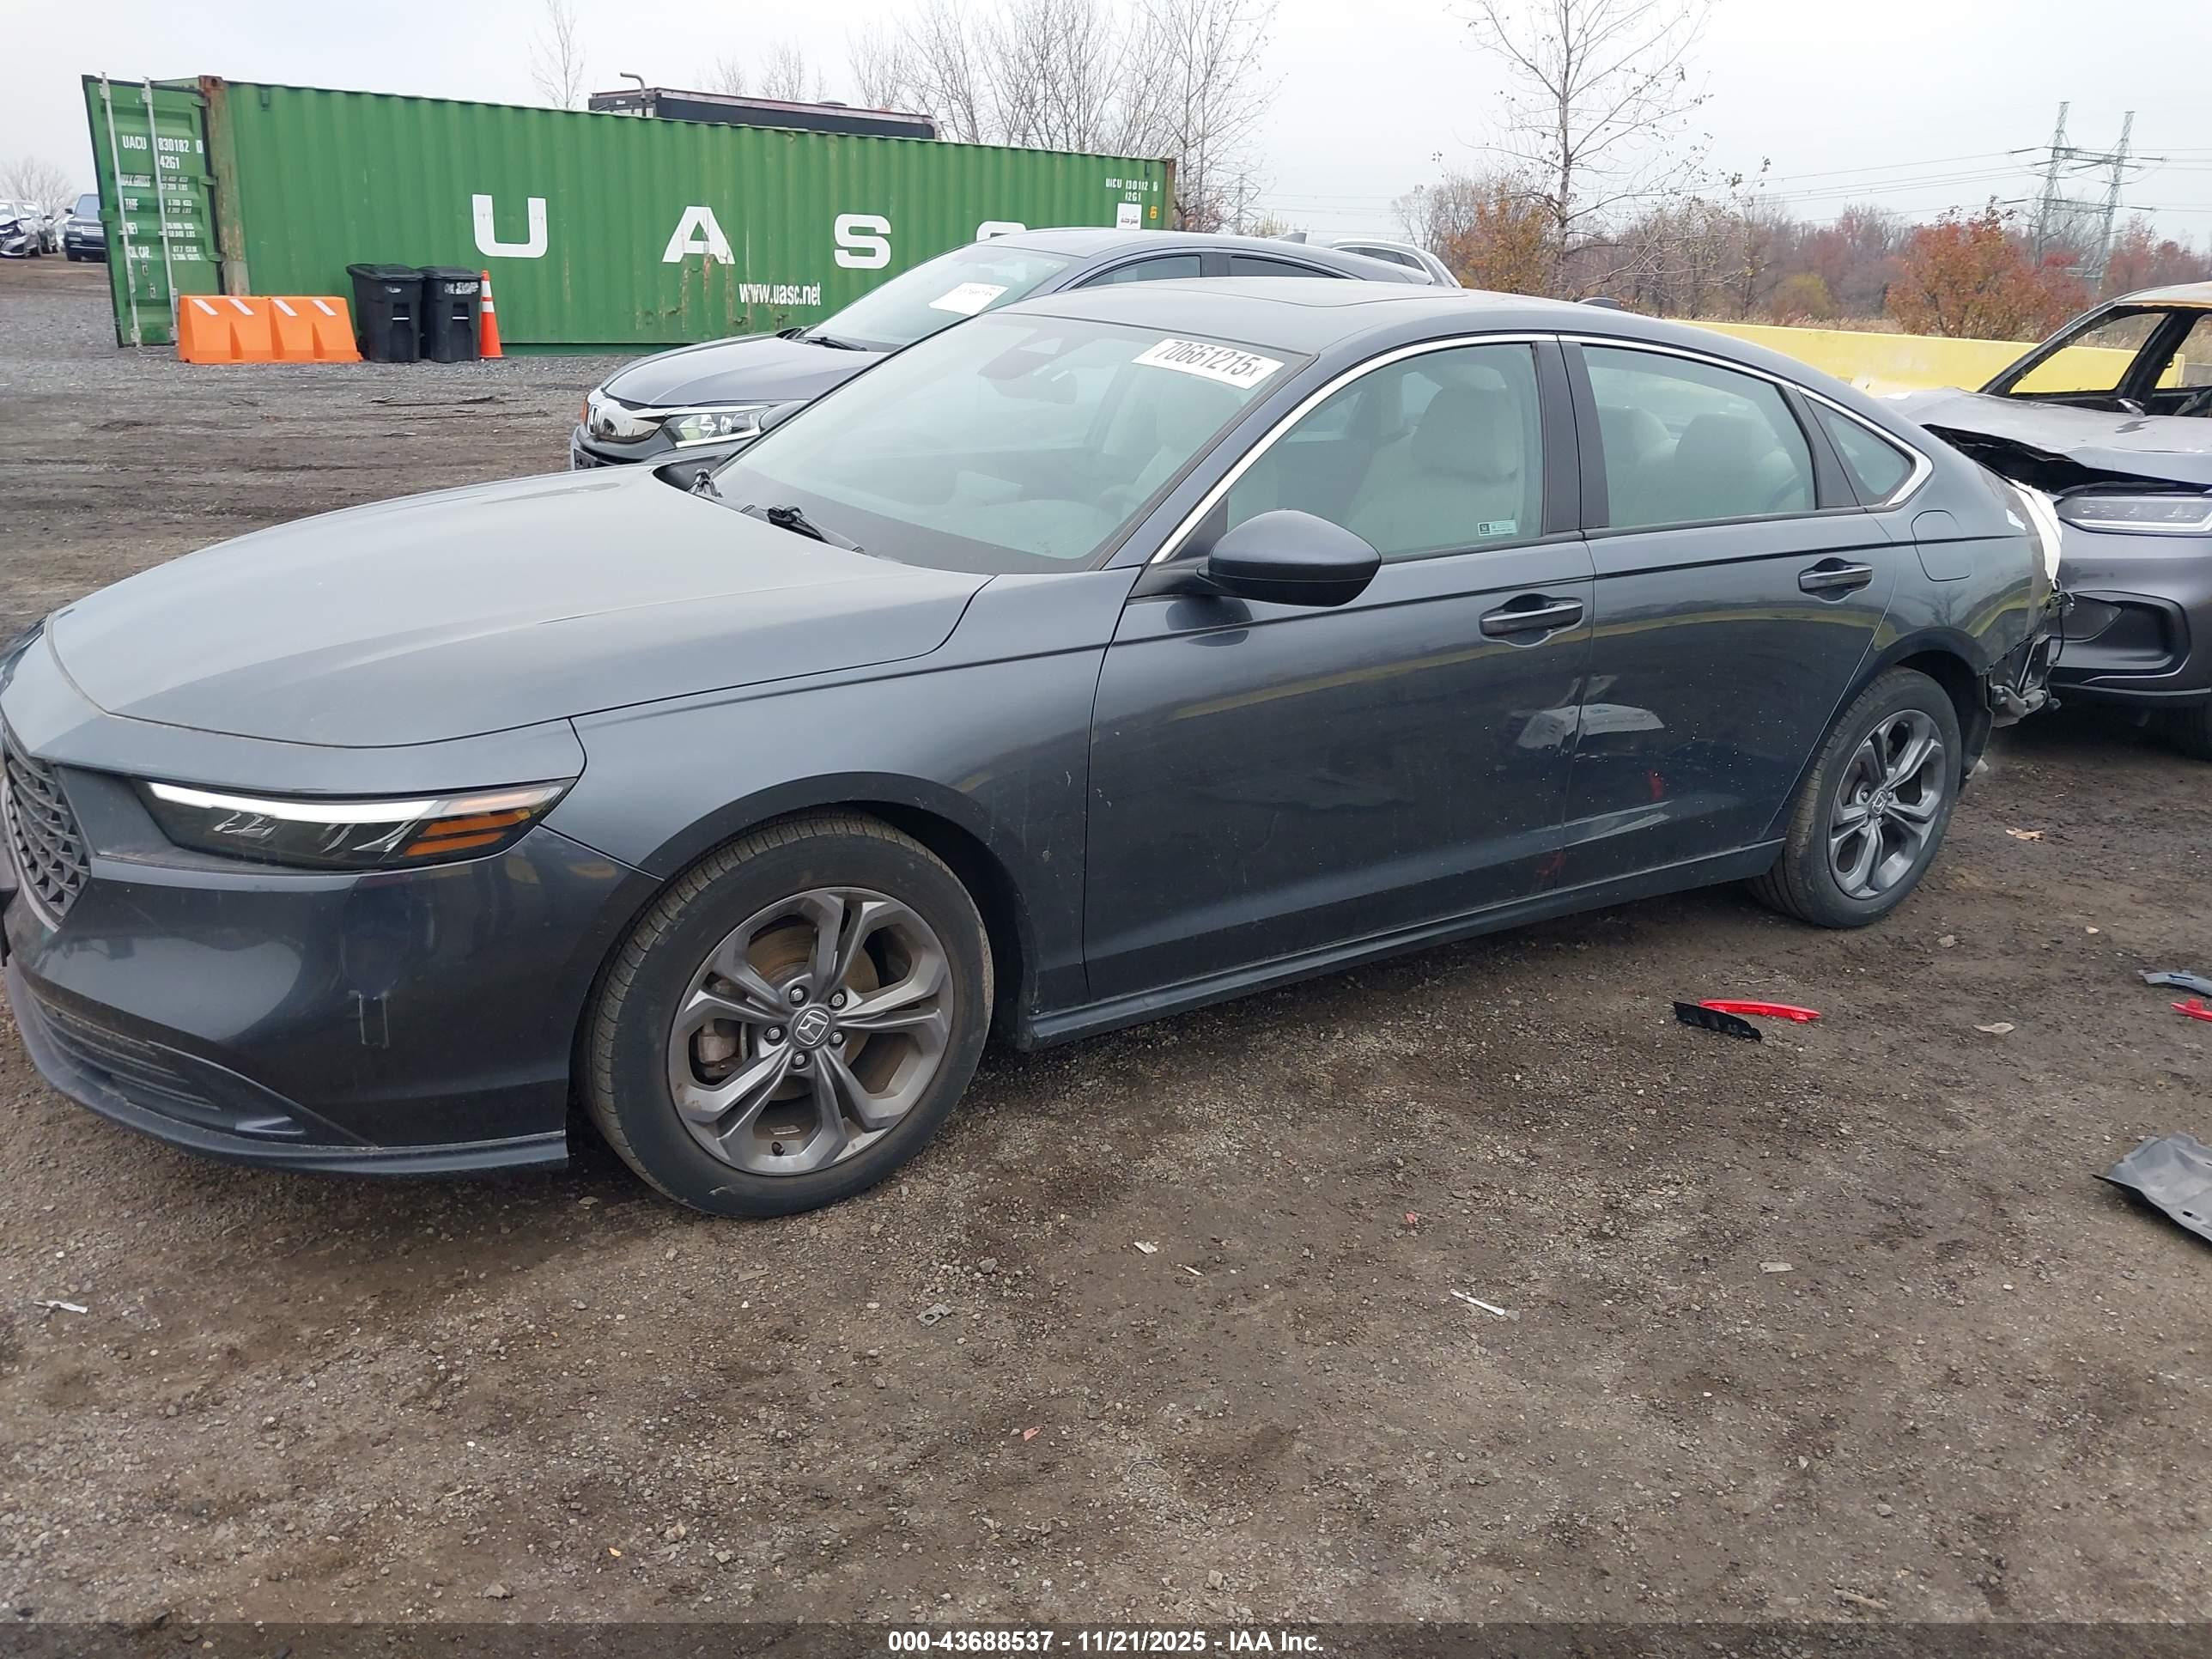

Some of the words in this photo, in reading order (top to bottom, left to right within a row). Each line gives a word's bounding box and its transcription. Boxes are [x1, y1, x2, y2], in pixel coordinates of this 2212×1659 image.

[122, 135, 148, 150] UACU
[157, 137, 191, 153] 830182
[738, 281, 821, 307] www.uasc.net
